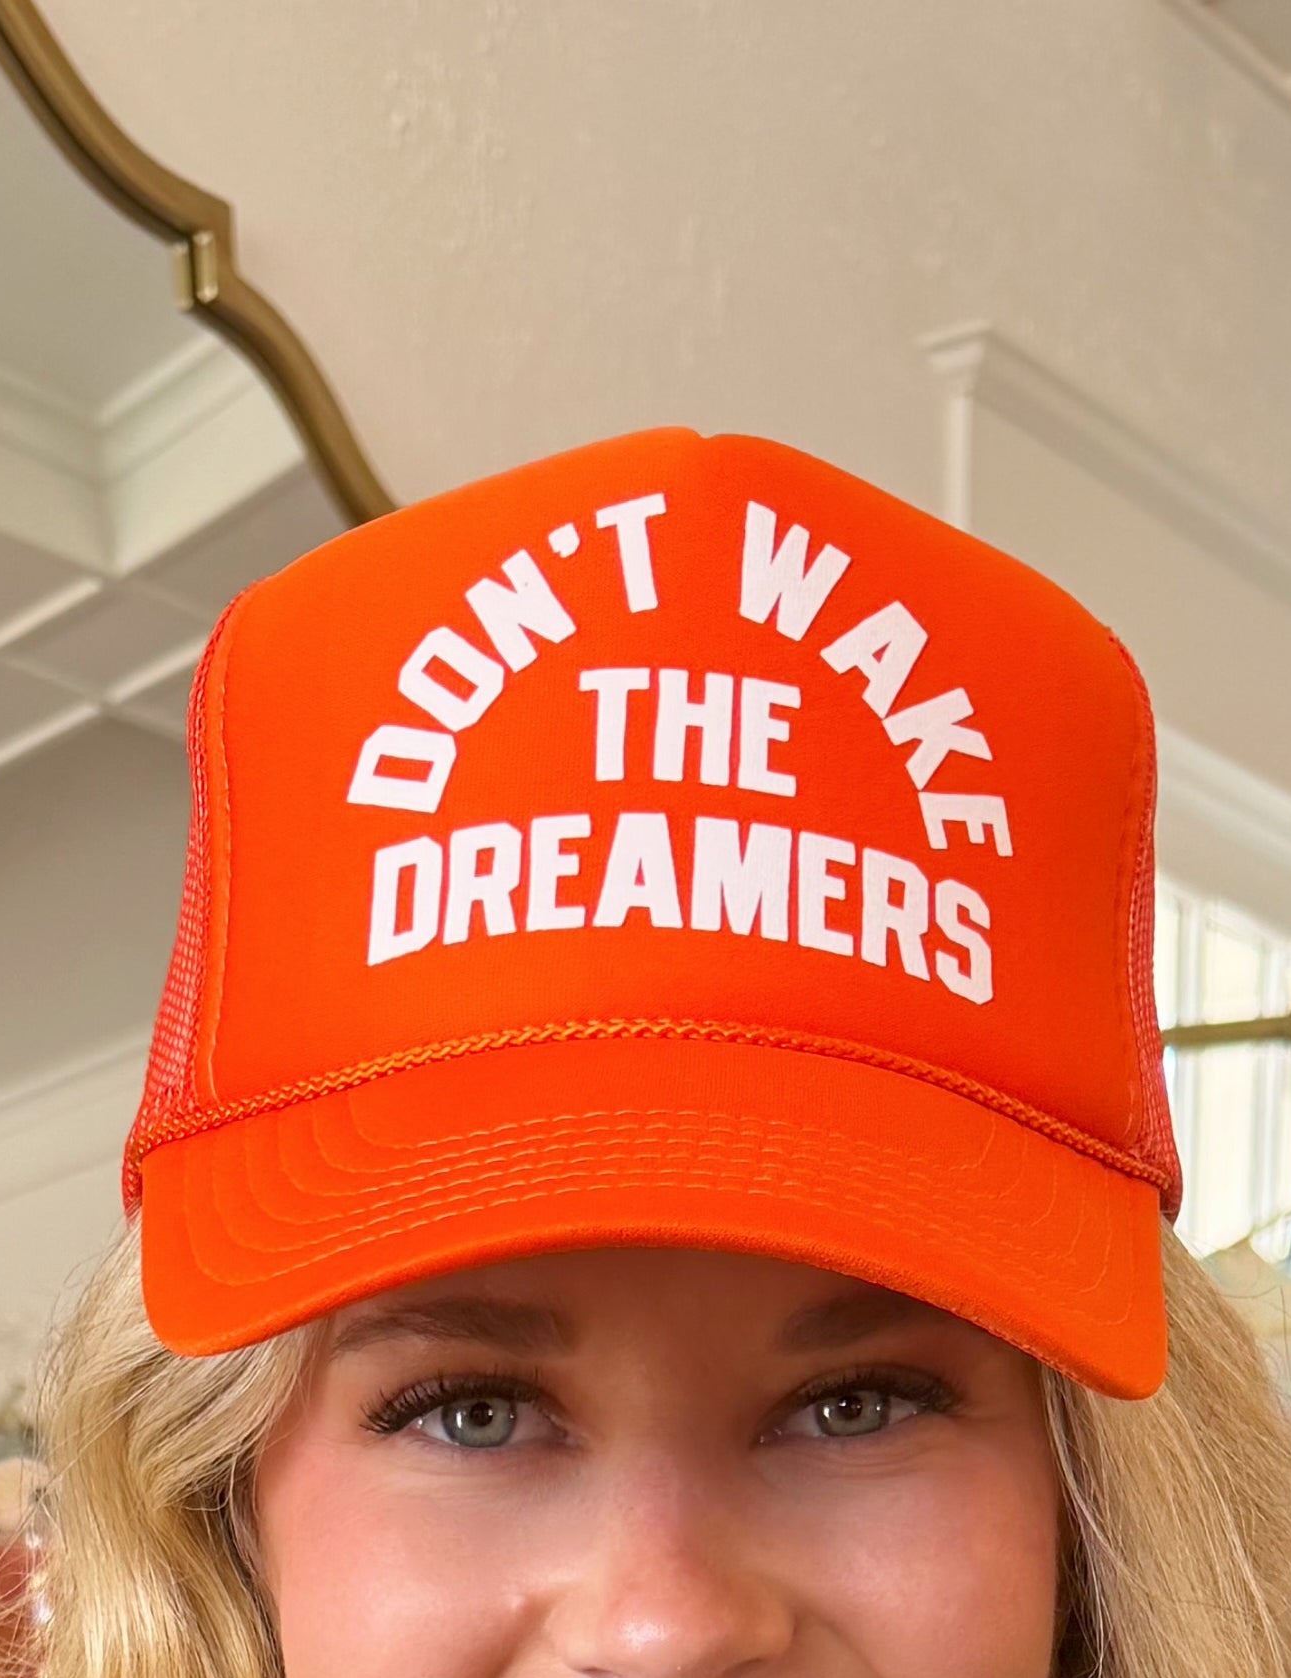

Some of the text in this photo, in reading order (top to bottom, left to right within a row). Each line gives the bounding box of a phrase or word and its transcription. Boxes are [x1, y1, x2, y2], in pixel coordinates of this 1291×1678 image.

[347, 493, 1013, 857] DON'T WAKE
[579, 667, 801, 797] THE
[366, 812, 994, 1005] DREAMERS
